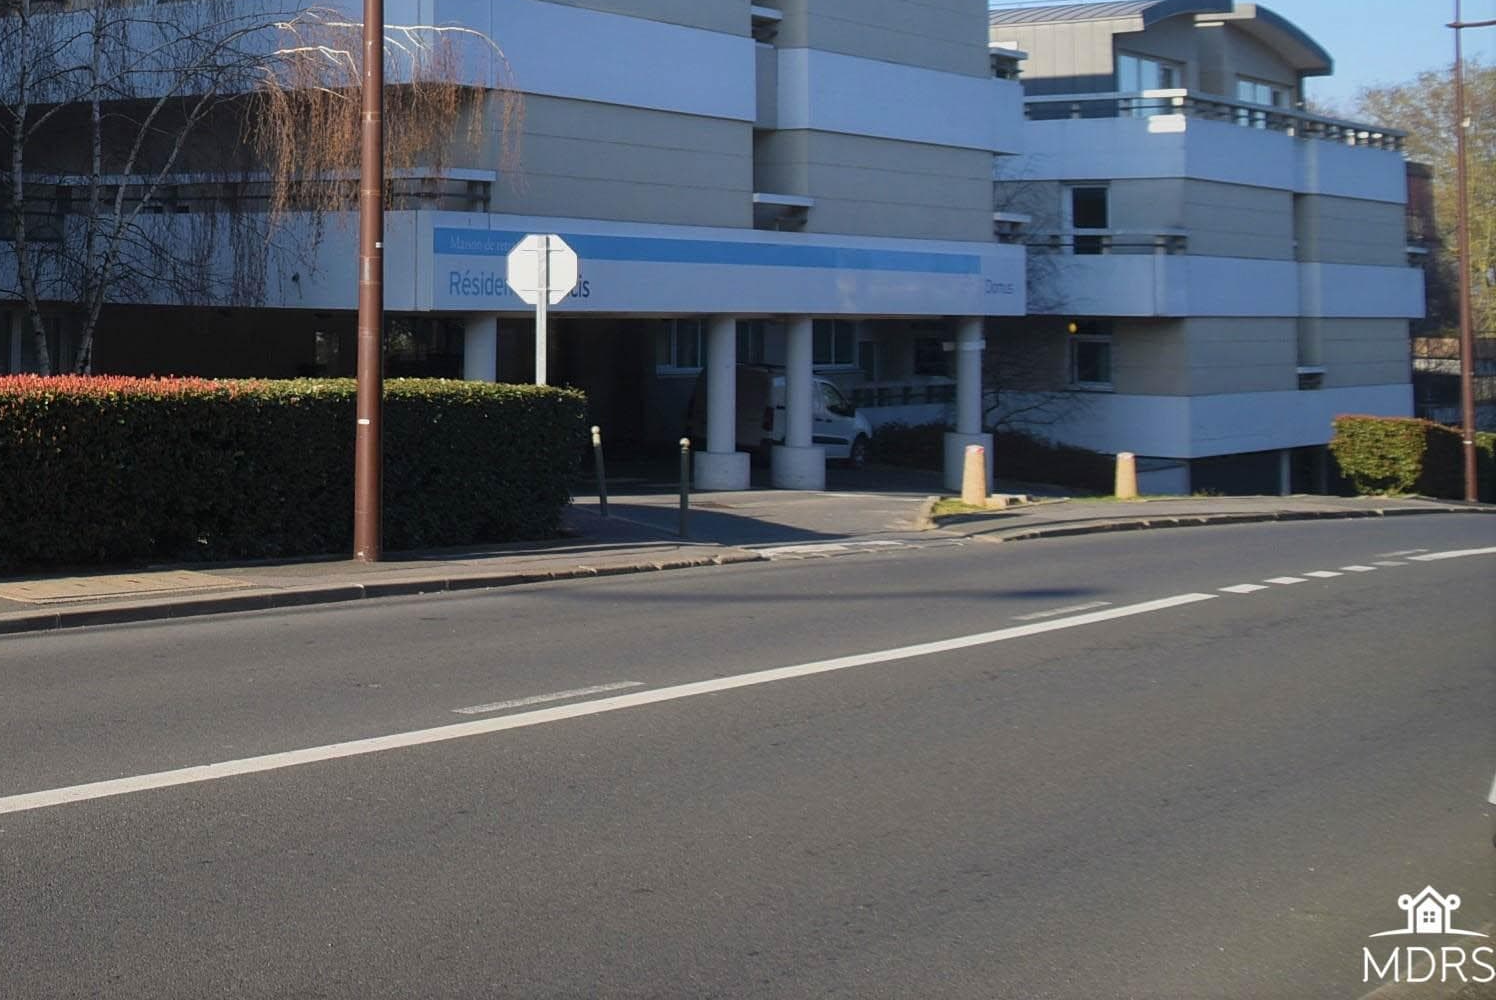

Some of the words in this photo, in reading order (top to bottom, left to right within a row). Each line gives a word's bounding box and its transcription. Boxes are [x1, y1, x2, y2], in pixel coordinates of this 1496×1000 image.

[449, 235, 481, 250] Maison
[449, 269, 513, 297] Résiden
[567, 274, 591, 298] cis
